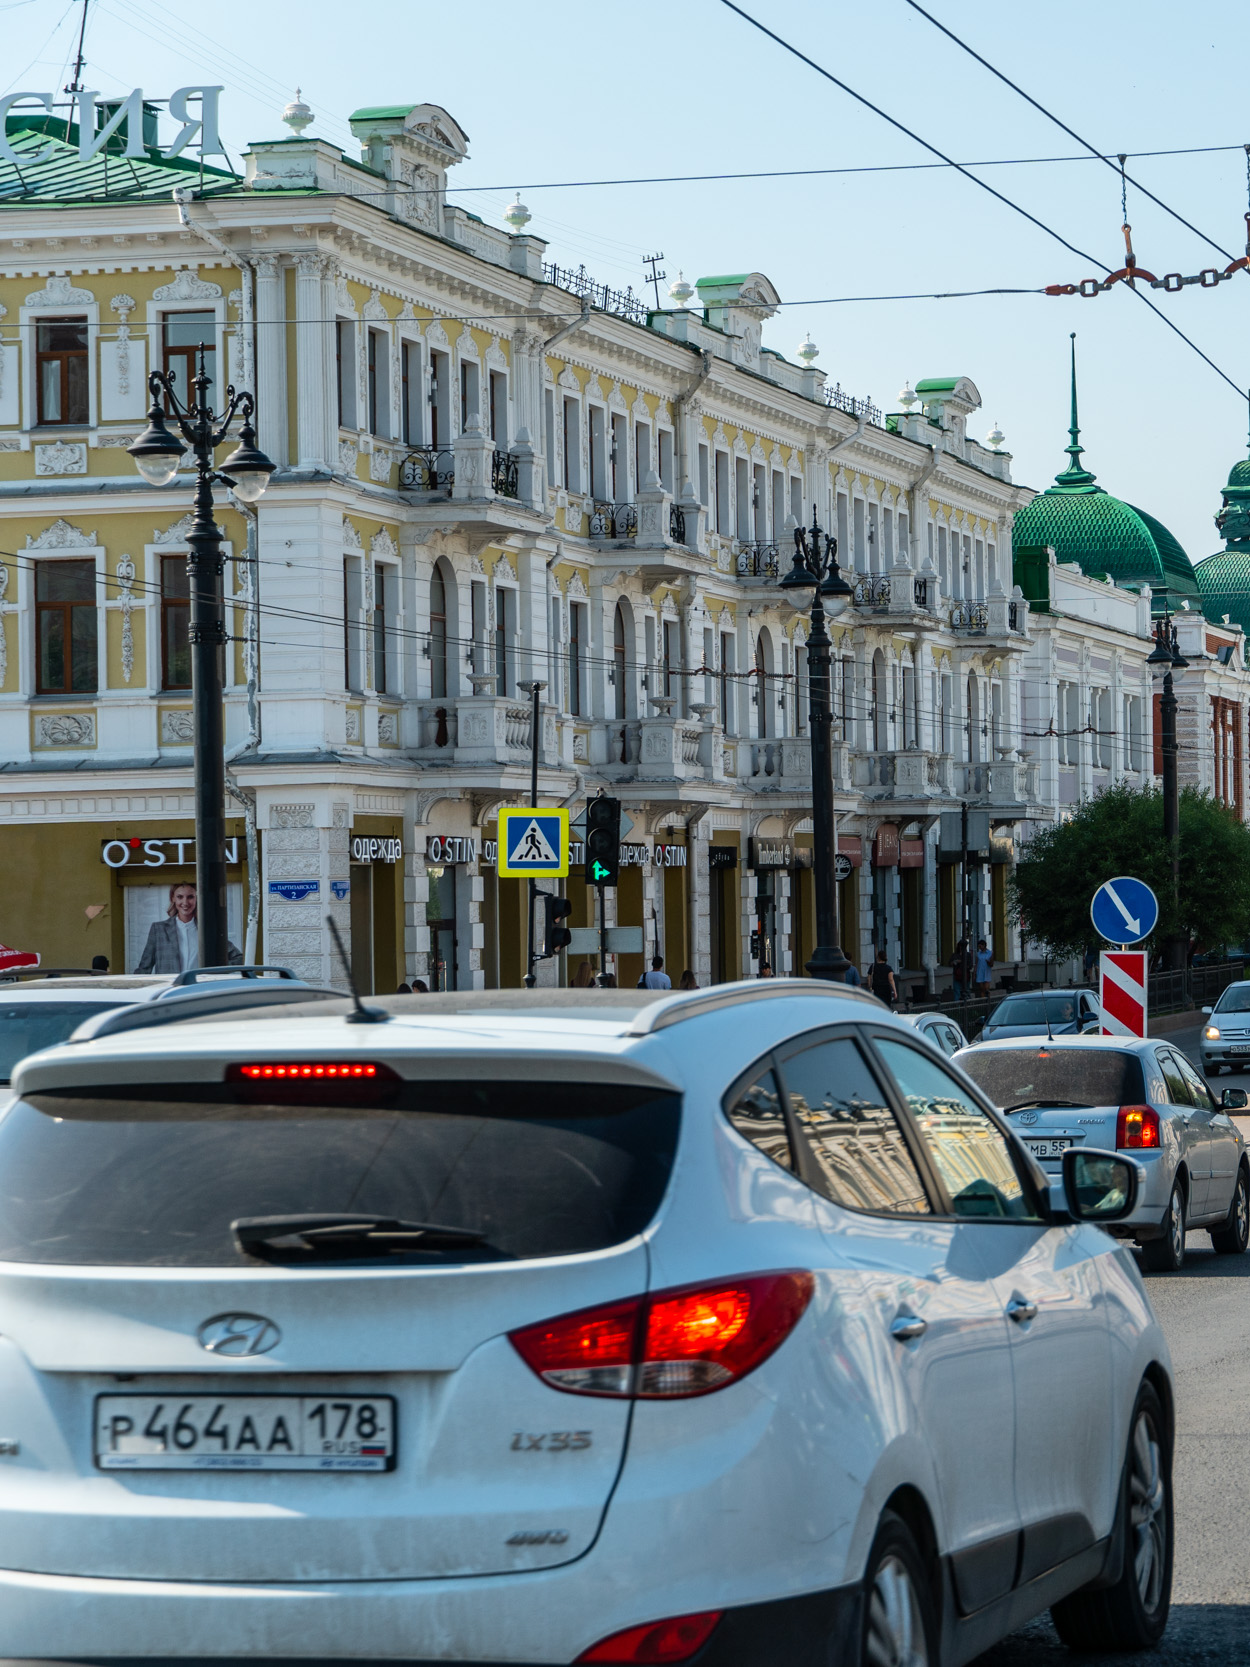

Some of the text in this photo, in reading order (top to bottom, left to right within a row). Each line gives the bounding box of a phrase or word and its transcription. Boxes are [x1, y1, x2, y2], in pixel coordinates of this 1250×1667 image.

[102, 837, 238, 868] O'STN
[353, 837, 402, 863] одежда
[430, 835, 477, 863] O'STIN
[656, 844, 687, 867] O'STIN
[291, 891, 297, 899] 2
[1051, 1141, 1066, 1152] 55
[110, 1403, 378, 1451] Р464АА 178
[322, 1440, 359, 1454] RUS
